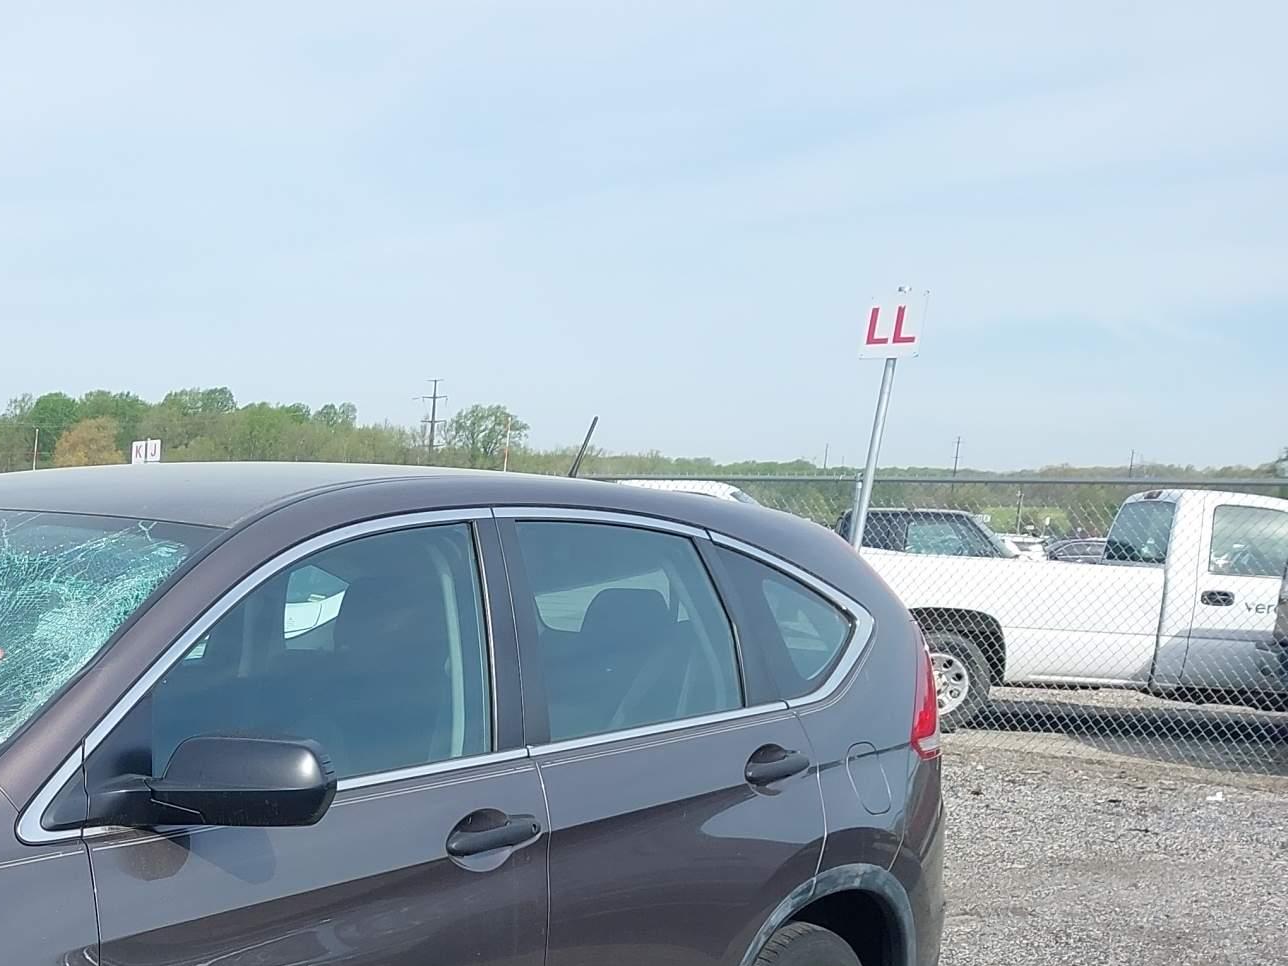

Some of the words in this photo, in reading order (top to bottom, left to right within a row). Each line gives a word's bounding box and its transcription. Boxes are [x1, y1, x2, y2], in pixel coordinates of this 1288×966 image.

[865, 305, 916, 345] LL
[135, 445, 143, 459] K
[151, 443, 157, 457] J
